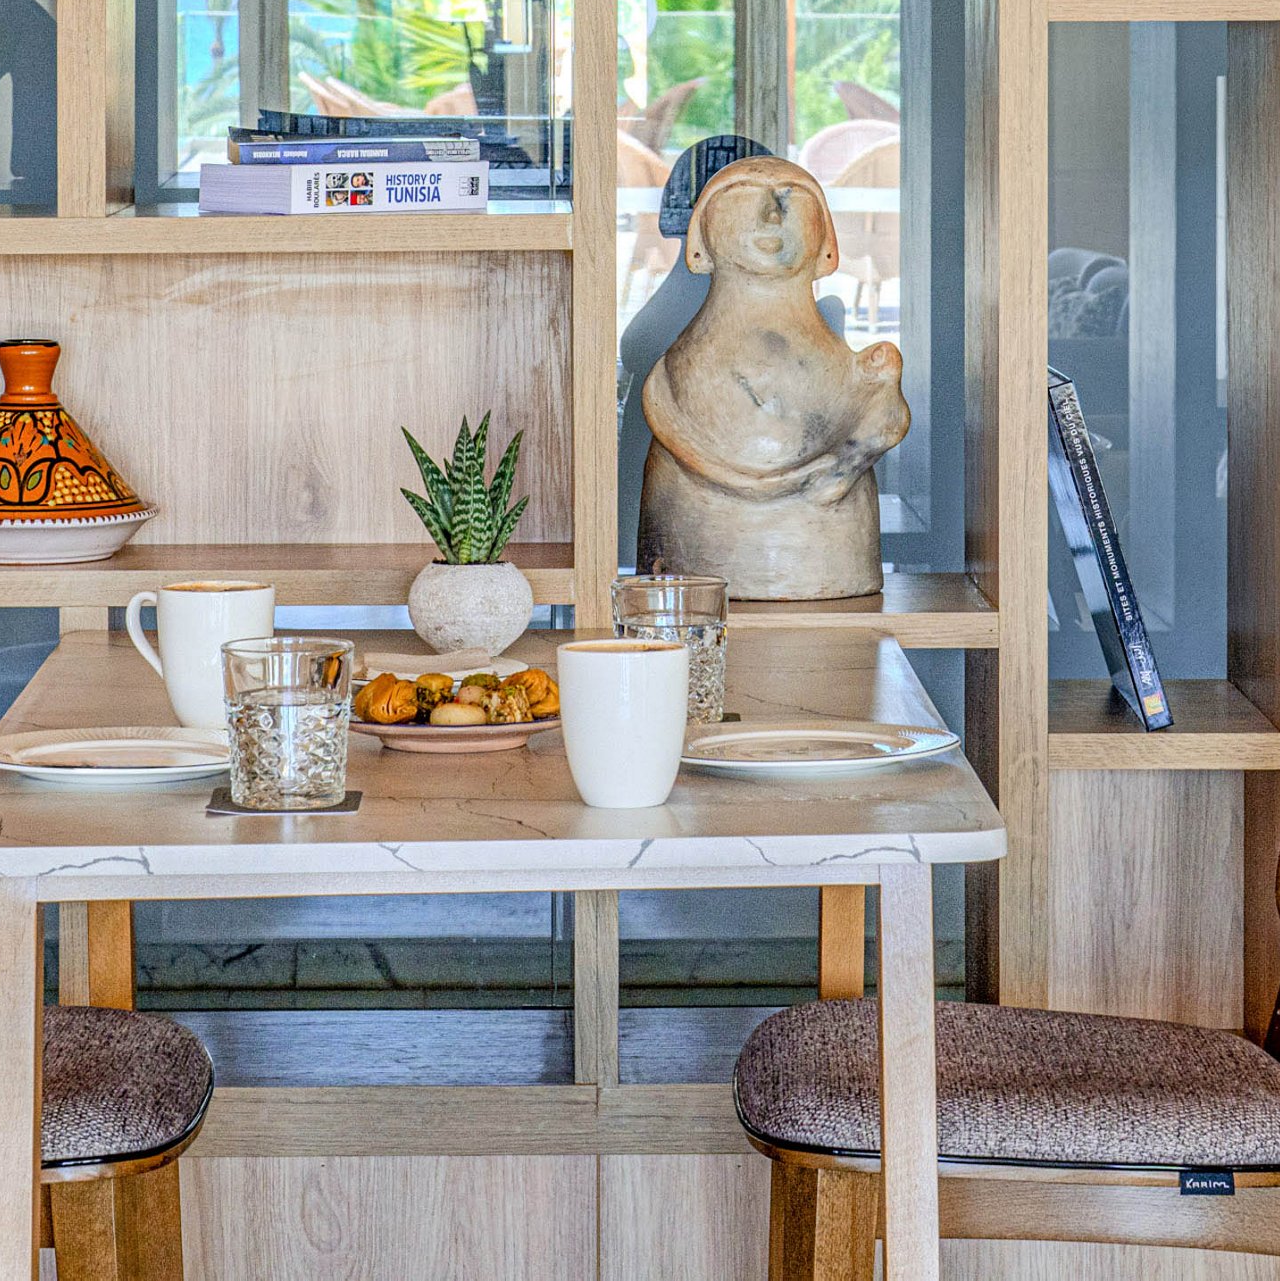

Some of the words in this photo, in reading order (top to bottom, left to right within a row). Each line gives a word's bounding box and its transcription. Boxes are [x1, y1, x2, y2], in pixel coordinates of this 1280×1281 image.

[386, 174, 427, 186] HISTORY
[429, 173, 443, 185] OF
[386, 186, 441, 203] TUNISIA
[1063, 398, 1073, 420] CIEL
[1068, 422, 1078, 435] DU
[1073, 437, 1084, 457] VUS
[1079, 458, 1103, 520] HISTORIQUES
[1097, 521, 1120, 579] MONUMENTS
[1115, 581, 1125, 593] ET
[1120, 595, 1133, 621] SITES
